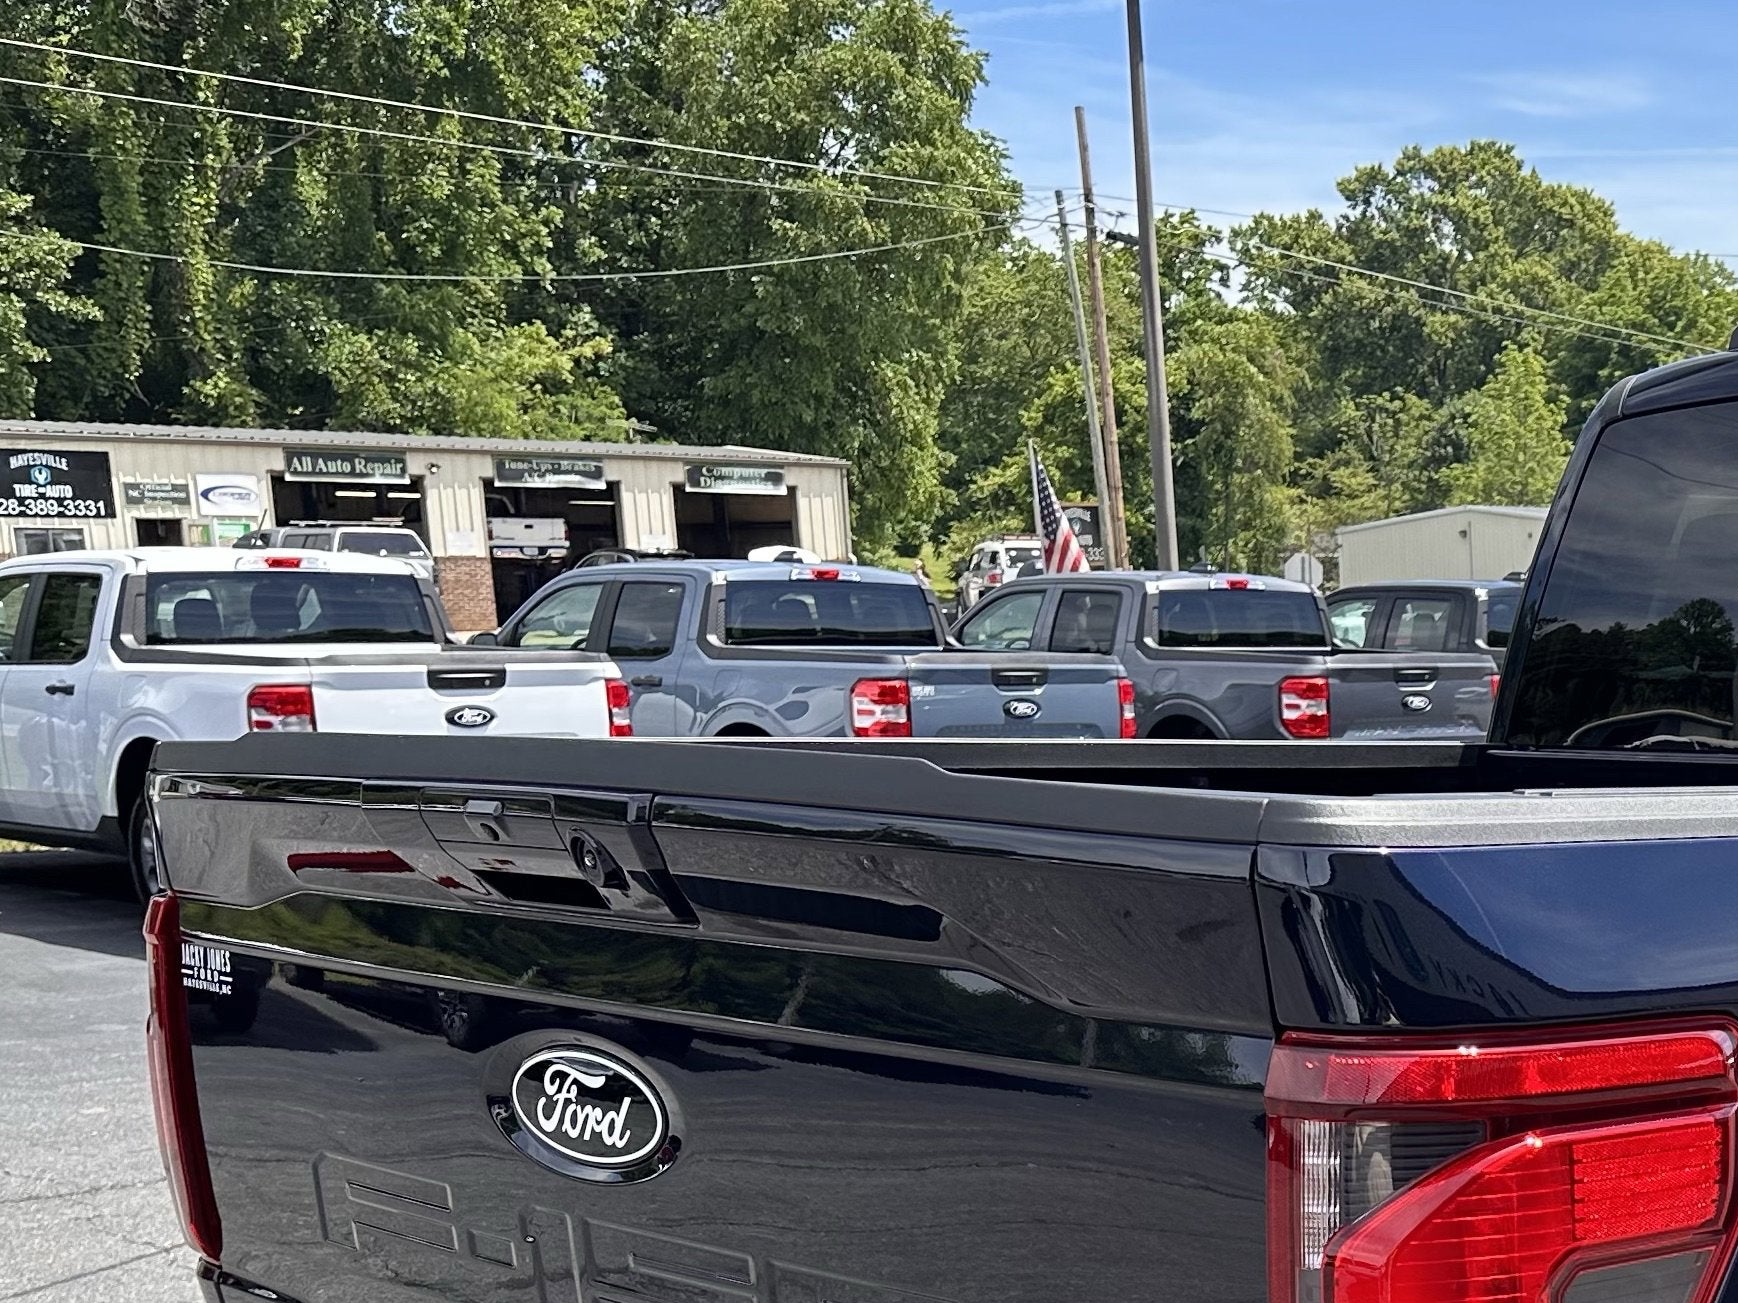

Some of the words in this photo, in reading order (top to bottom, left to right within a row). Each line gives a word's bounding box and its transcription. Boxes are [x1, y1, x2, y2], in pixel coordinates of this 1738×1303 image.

[9, 452, 69, 471] HAYESVILLE
[290, 456, 313, 473] All
[315, 457, 352, 474] Auto
[354, 458, 404, 479] Repair
[701, 465, 767, 479] Computer
[0, 498, 106, 517] 28-389-3331
[181, 942, 204, 967] JACKY
[206, 946, 231, 973] JONES
[193, 966, 219, 983] FORD
[535, 1062, 632, 1150] Ford
